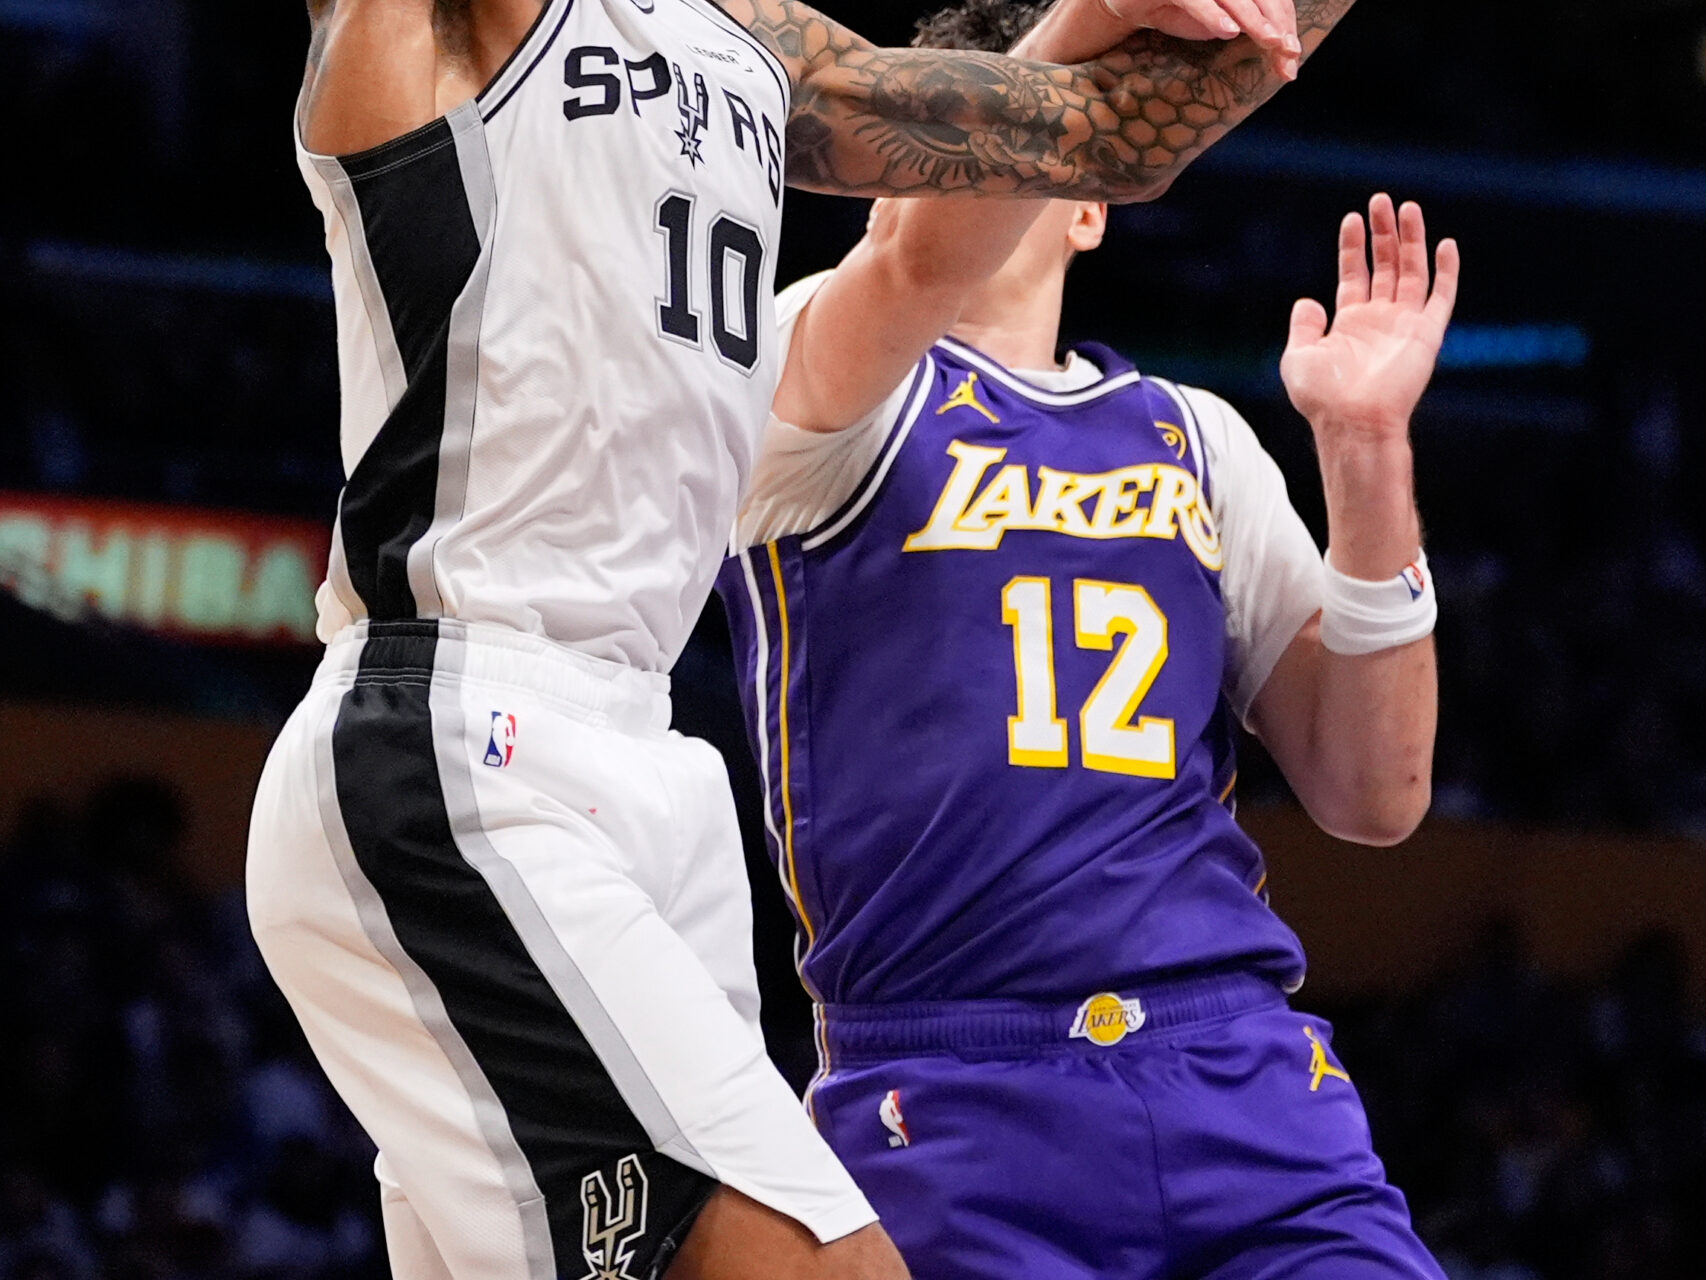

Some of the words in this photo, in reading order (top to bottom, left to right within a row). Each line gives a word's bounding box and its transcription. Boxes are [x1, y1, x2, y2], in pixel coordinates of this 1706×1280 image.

[562, 46, 784, 209] SPURS
[653, 188, 768, 379] 10
[902, 438, 1225, 571] LAKERS
[1001, 575, 1176, 779] 12
